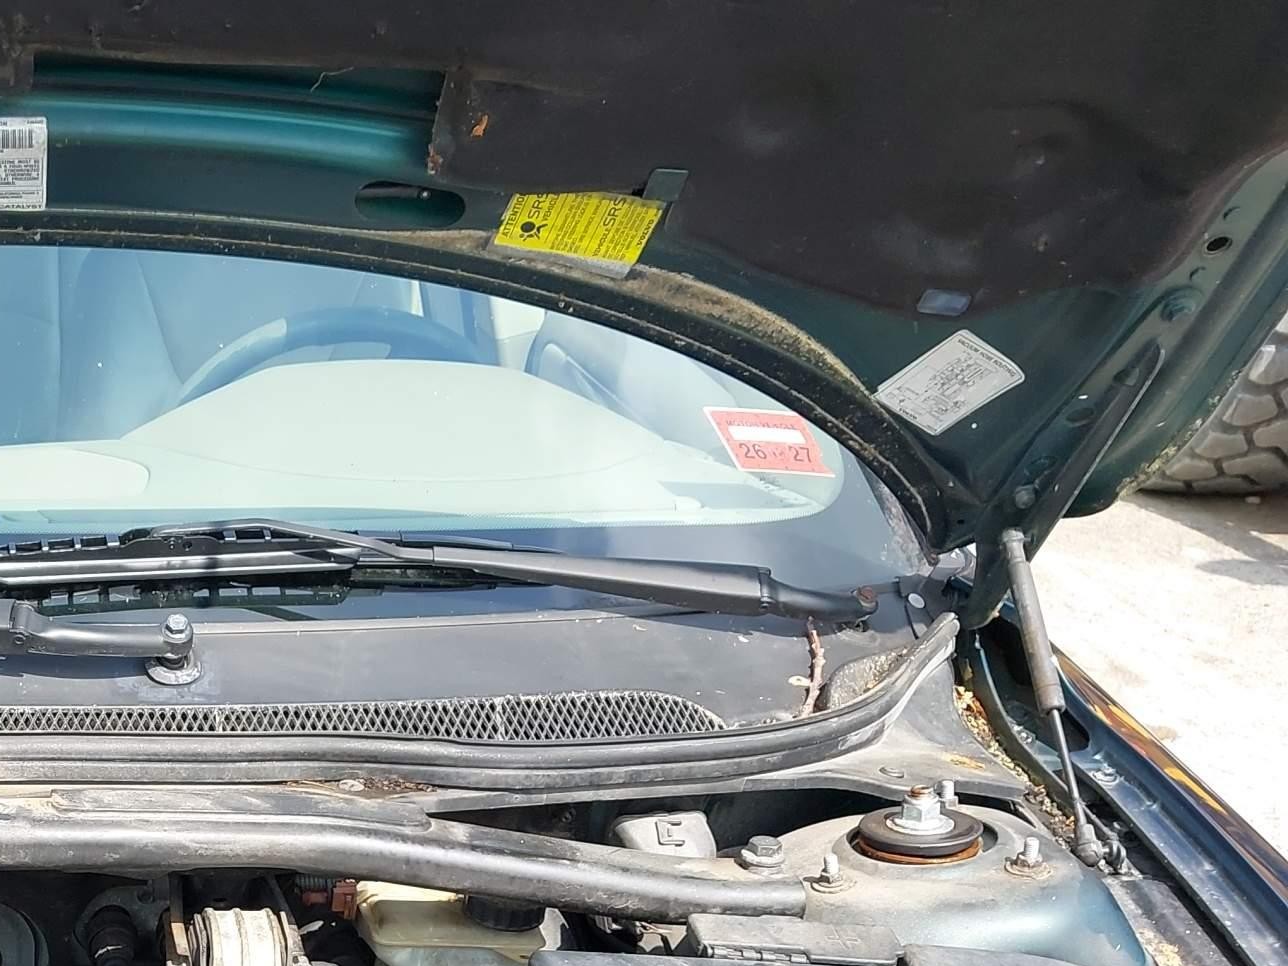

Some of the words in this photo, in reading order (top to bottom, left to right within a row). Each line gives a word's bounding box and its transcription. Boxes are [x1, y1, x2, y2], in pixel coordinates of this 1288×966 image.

[602, 197, 627, 227] SRS
[637, 219, 655, 246] VOLVO
[957, 338, 981, 354] VACUUM
[993, 359, 1016, 378] ROUTING
[739, 443, 768, 460] 26
[788, 446, 812, 463] 27
